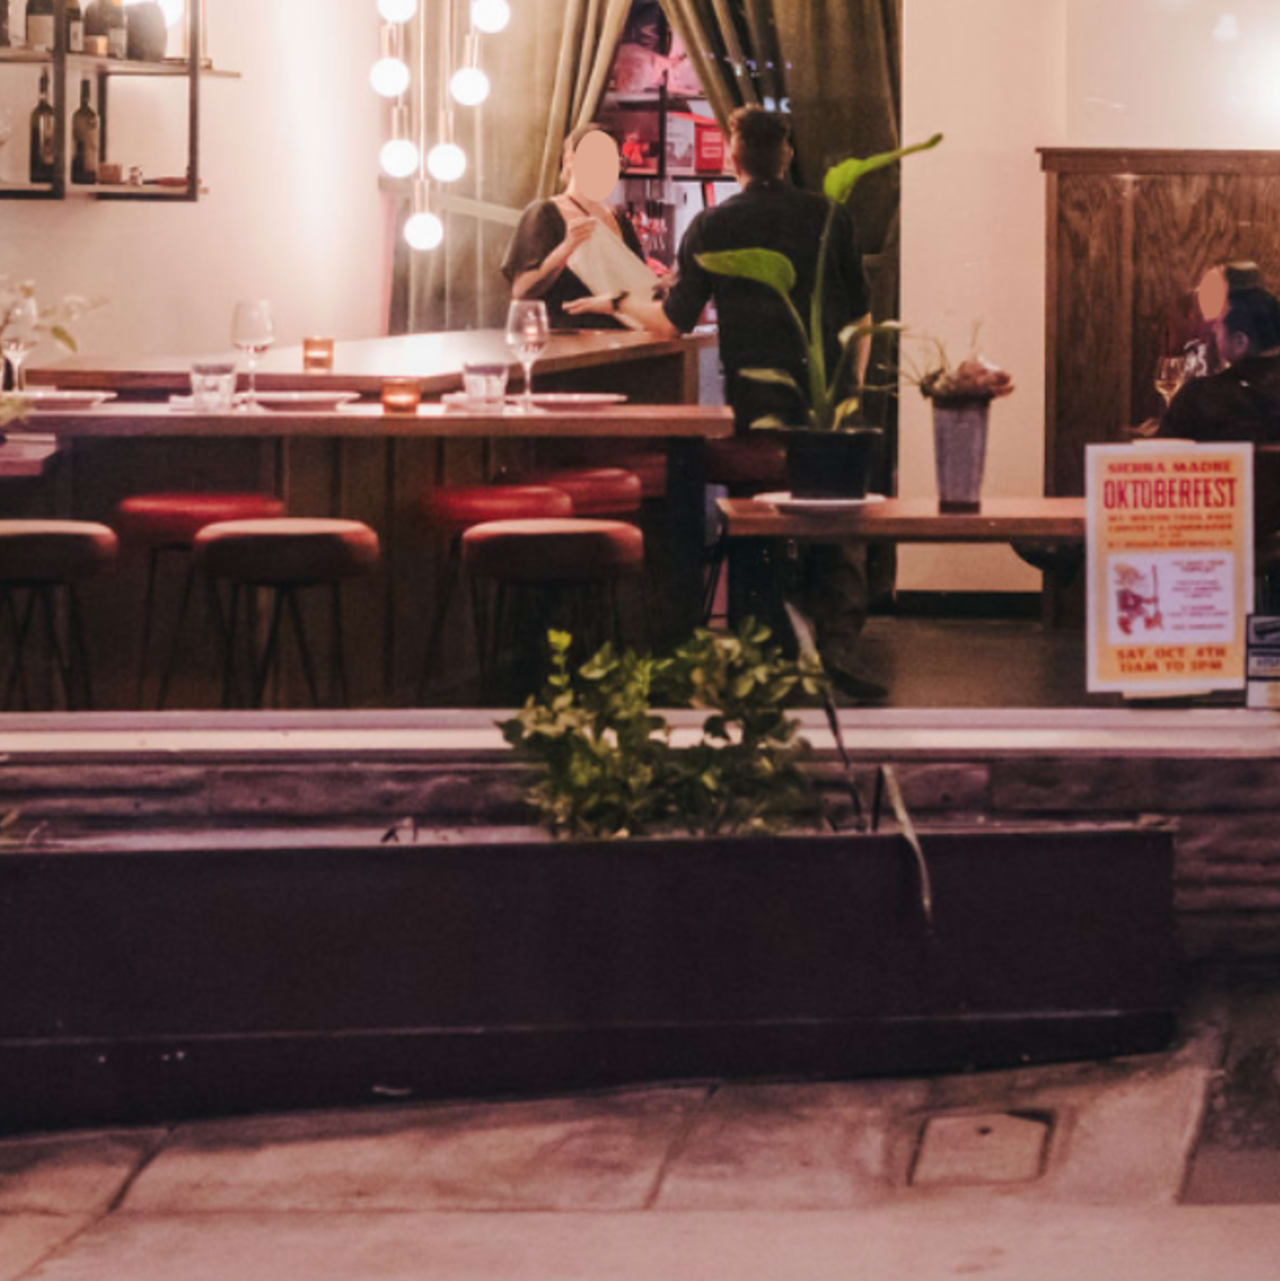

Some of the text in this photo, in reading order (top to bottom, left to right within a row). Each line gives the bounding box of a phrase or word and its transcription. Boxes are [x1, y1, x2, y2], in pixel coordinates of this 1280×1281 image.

[1103, 477, 1237, 509] OKTOBERFEST
[1154, 647, 1185, 658] OCT
[1166, 661, 1185, 672] TO
